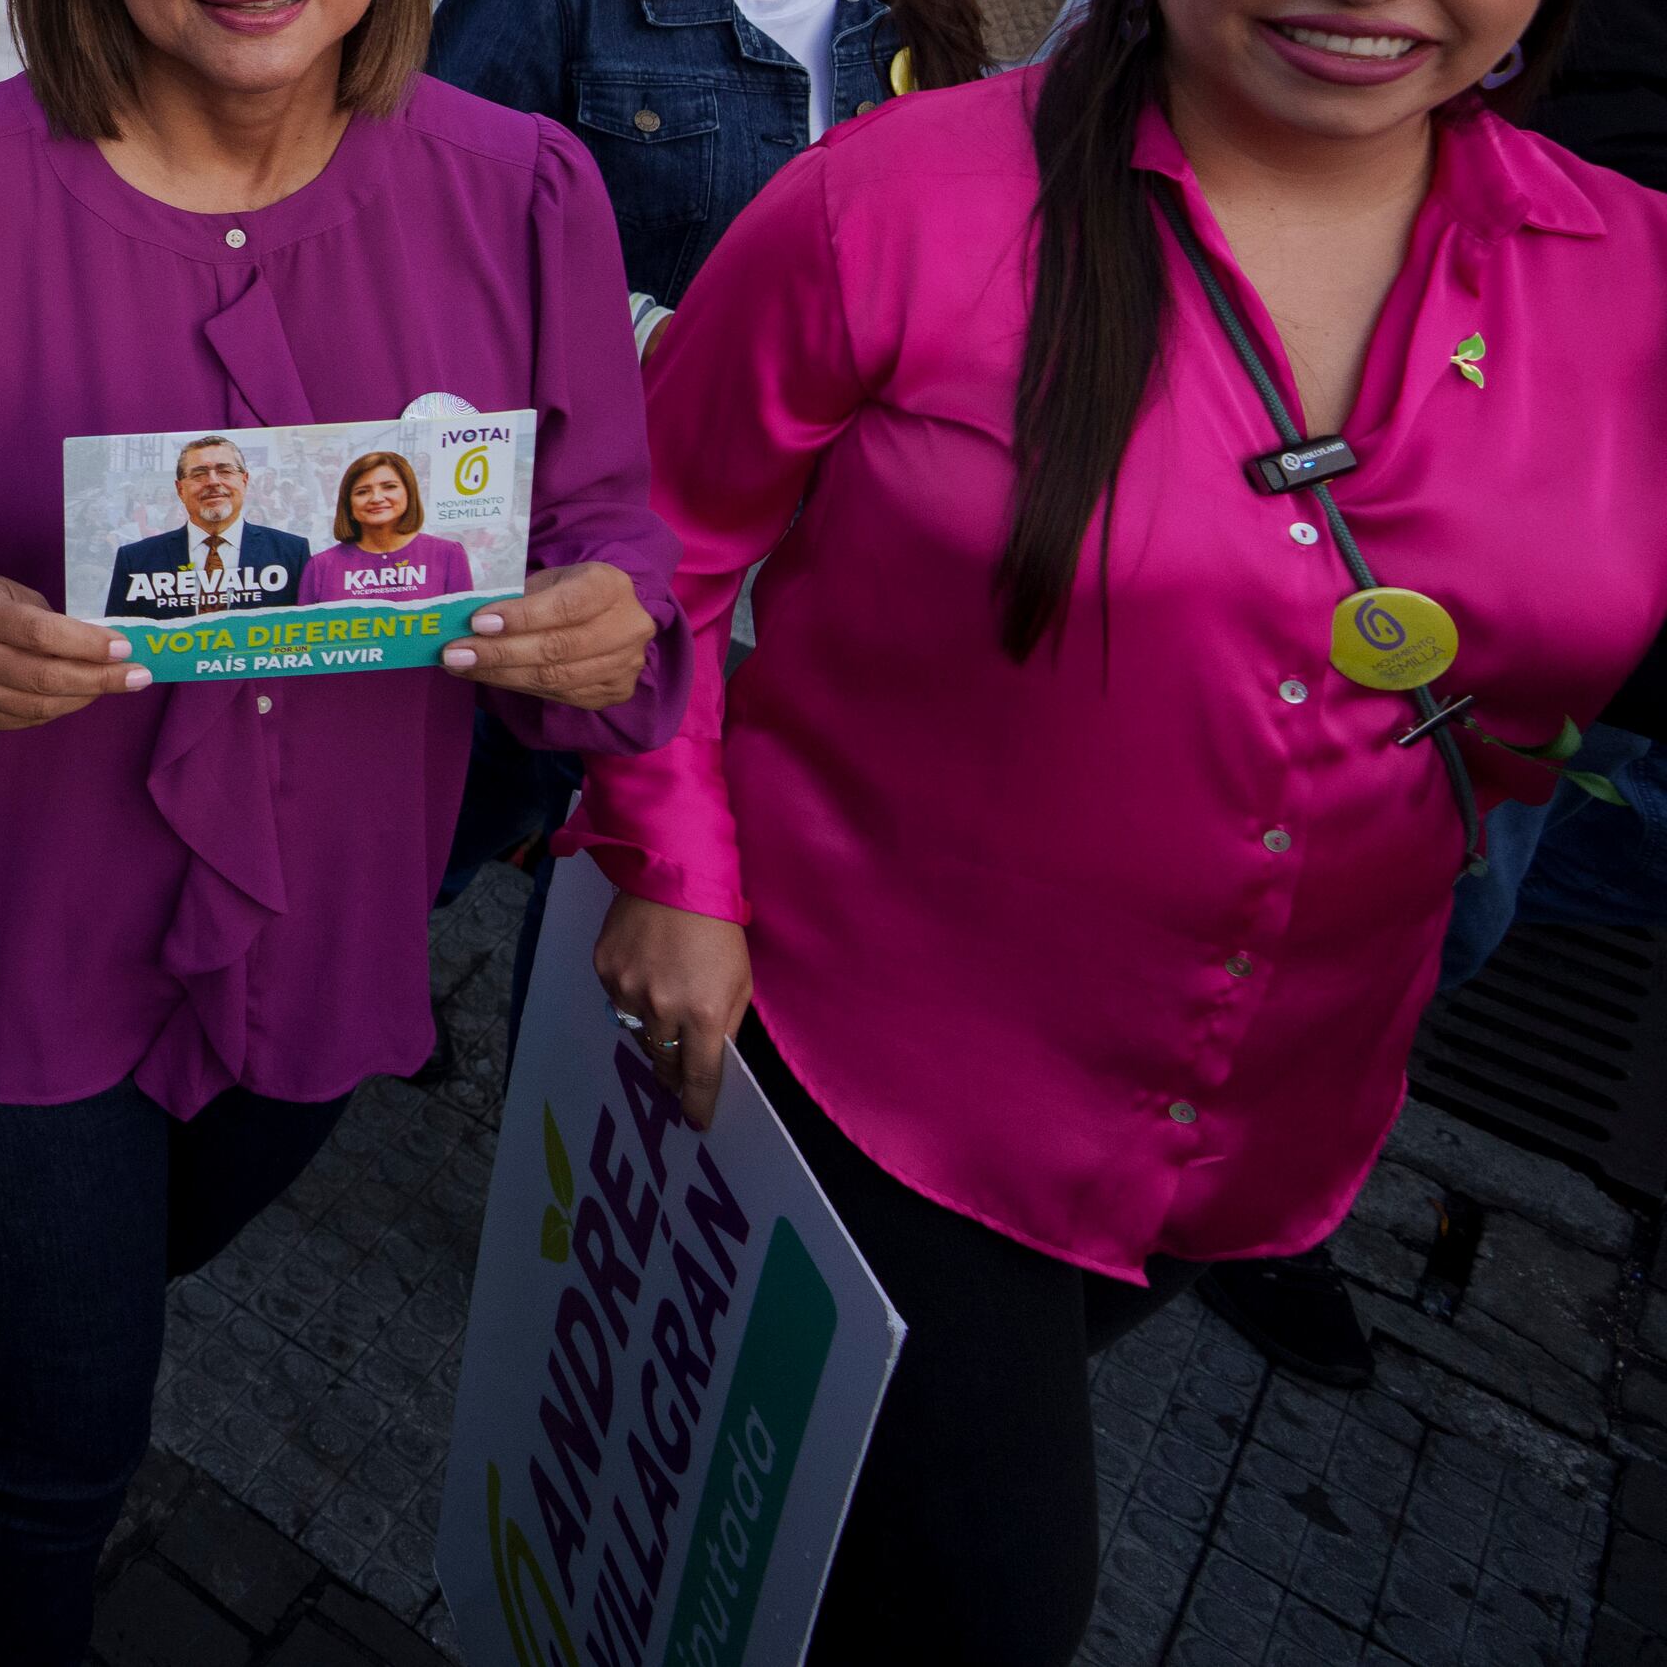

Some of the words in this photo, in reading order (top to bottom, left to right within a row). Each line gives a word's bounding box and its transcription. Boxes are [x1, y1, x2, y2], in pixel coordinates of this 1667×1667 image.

[441, 427, 510, 448] ¡VOTA!
[1299, 442, 1346, 462] HOLLYLAND
[436, 496, 505, 509] MOVIMIENTO
[438, 506, 502, 520] SEMILLA
[157, 591, 262, 609] PRESIDENTE
[351, 585, 419, 597] VICEPRESIDENTA
[145, 628, 235, 655] VOTA
[247, 613, 442, 648] DIFERENTE
[273, 646, 294, 654] POR
[295, 645, 308, 653] UN
[195, 654, 247, 675] PAÍS
[253, 653, 314, 671] PARA
[321, 647, 384, 667] VIVIR
[529, 1039, 681, 1608] ANDREA
[673, 1404, 777, 1667] iputada
